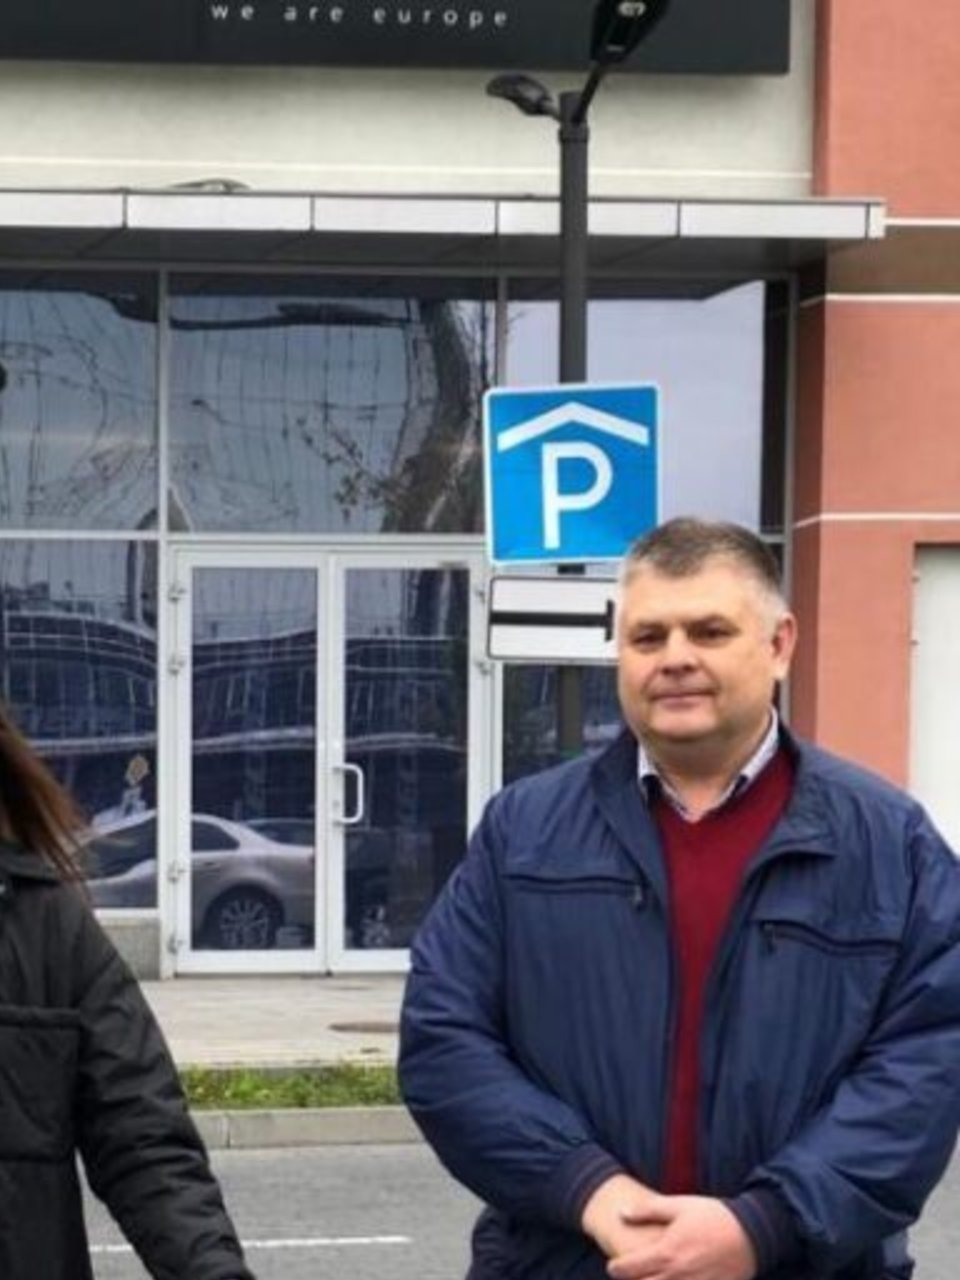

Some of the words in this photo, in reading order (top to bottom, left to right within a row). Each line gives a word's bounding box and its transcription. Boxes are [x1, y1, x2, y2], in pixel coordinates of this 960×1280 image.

[211, 3, 254, 20] we
[284, 6, 343, 22] are
[374, 8, 507, 28] europe
[542, 441, 613, 549] P
